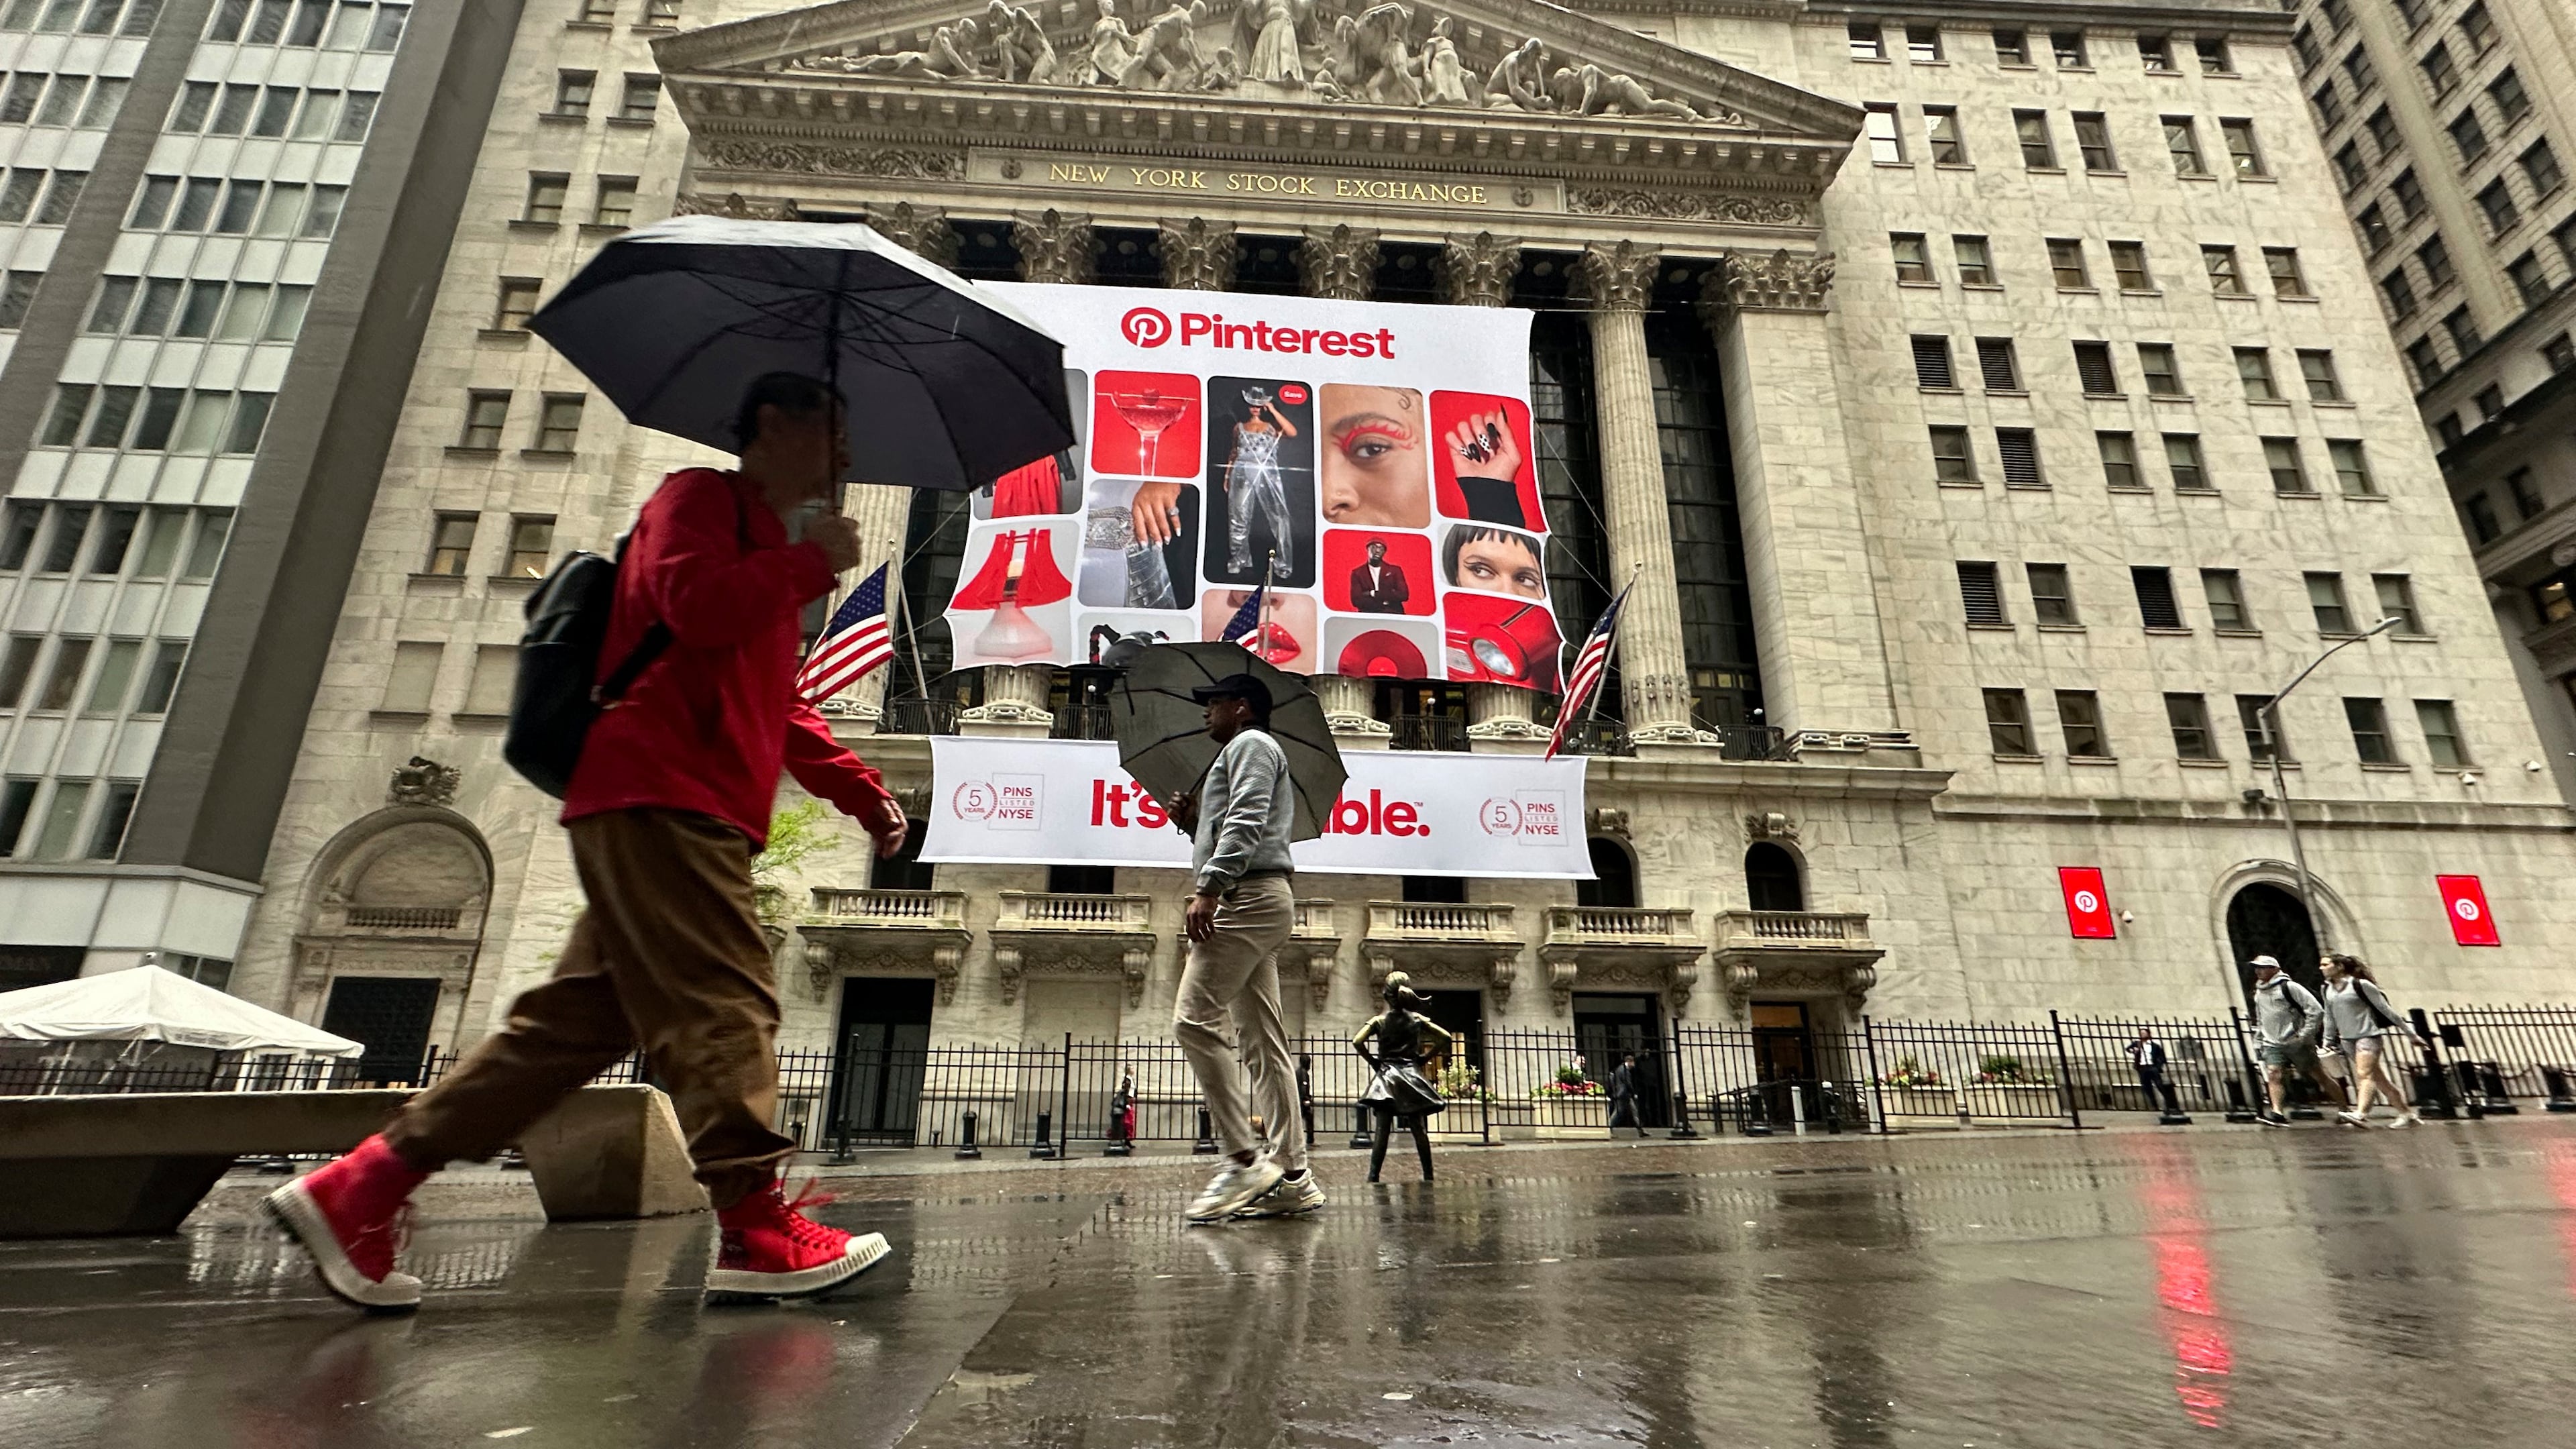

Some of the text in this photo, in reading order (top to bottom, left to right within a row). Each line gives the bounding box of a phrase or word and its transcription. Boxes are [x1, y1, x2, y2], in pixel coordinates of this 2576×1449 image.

[1049, 163, 1487, 204] NEW YORK STOCK EXCHANGE
[1180, 313, 1395, 360] Pinterest
[969, 790, 981, 807] 5
[1003, 787, 1032, 797] PINS
[1091, 780, 1168, 828] It's
[1527, 803, 1555, 813] PINS
[998, 809, 1034, 819] NYSE
[1495, 806, 1507, 822] 5
[1525, 824, 1559, 835] NYSE
